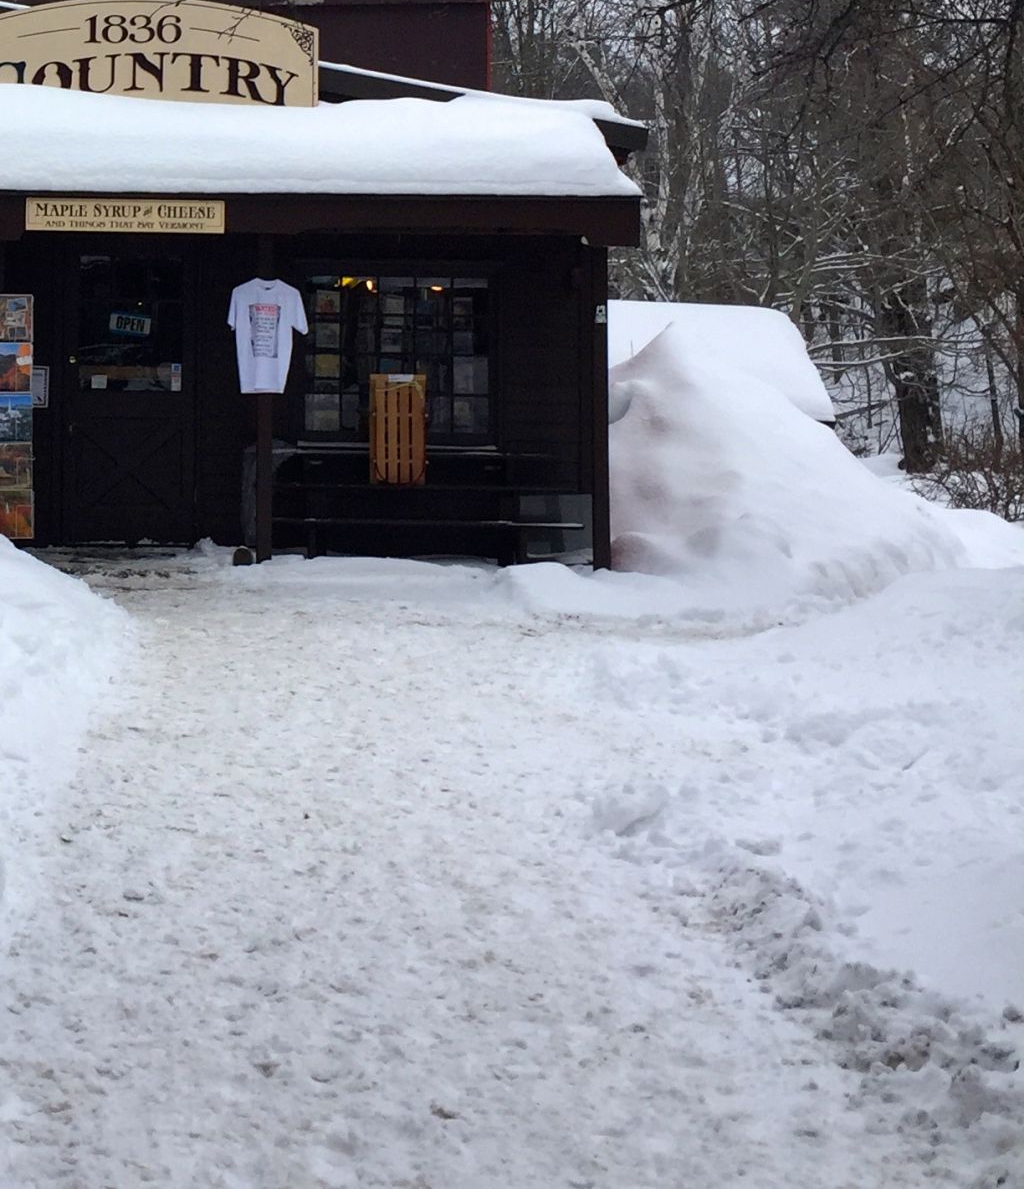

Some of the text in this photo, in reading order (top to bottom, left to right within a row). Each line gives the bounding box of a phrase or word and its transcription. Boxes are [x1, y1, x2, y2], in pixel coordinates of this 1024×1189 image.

[83, 13, 182, 44] 1836
[35, 203, 88, 218] MAPLE
[93, 203, 142, 218] SYRUP
[157, 204, 216, 220] CHEESE
[45, 220, 66, 228] AND
[70, 220, 106, 228] THINGS
[159, 221, 205, 230] VERMONT
[116, 316, 145, 332] OPEN
